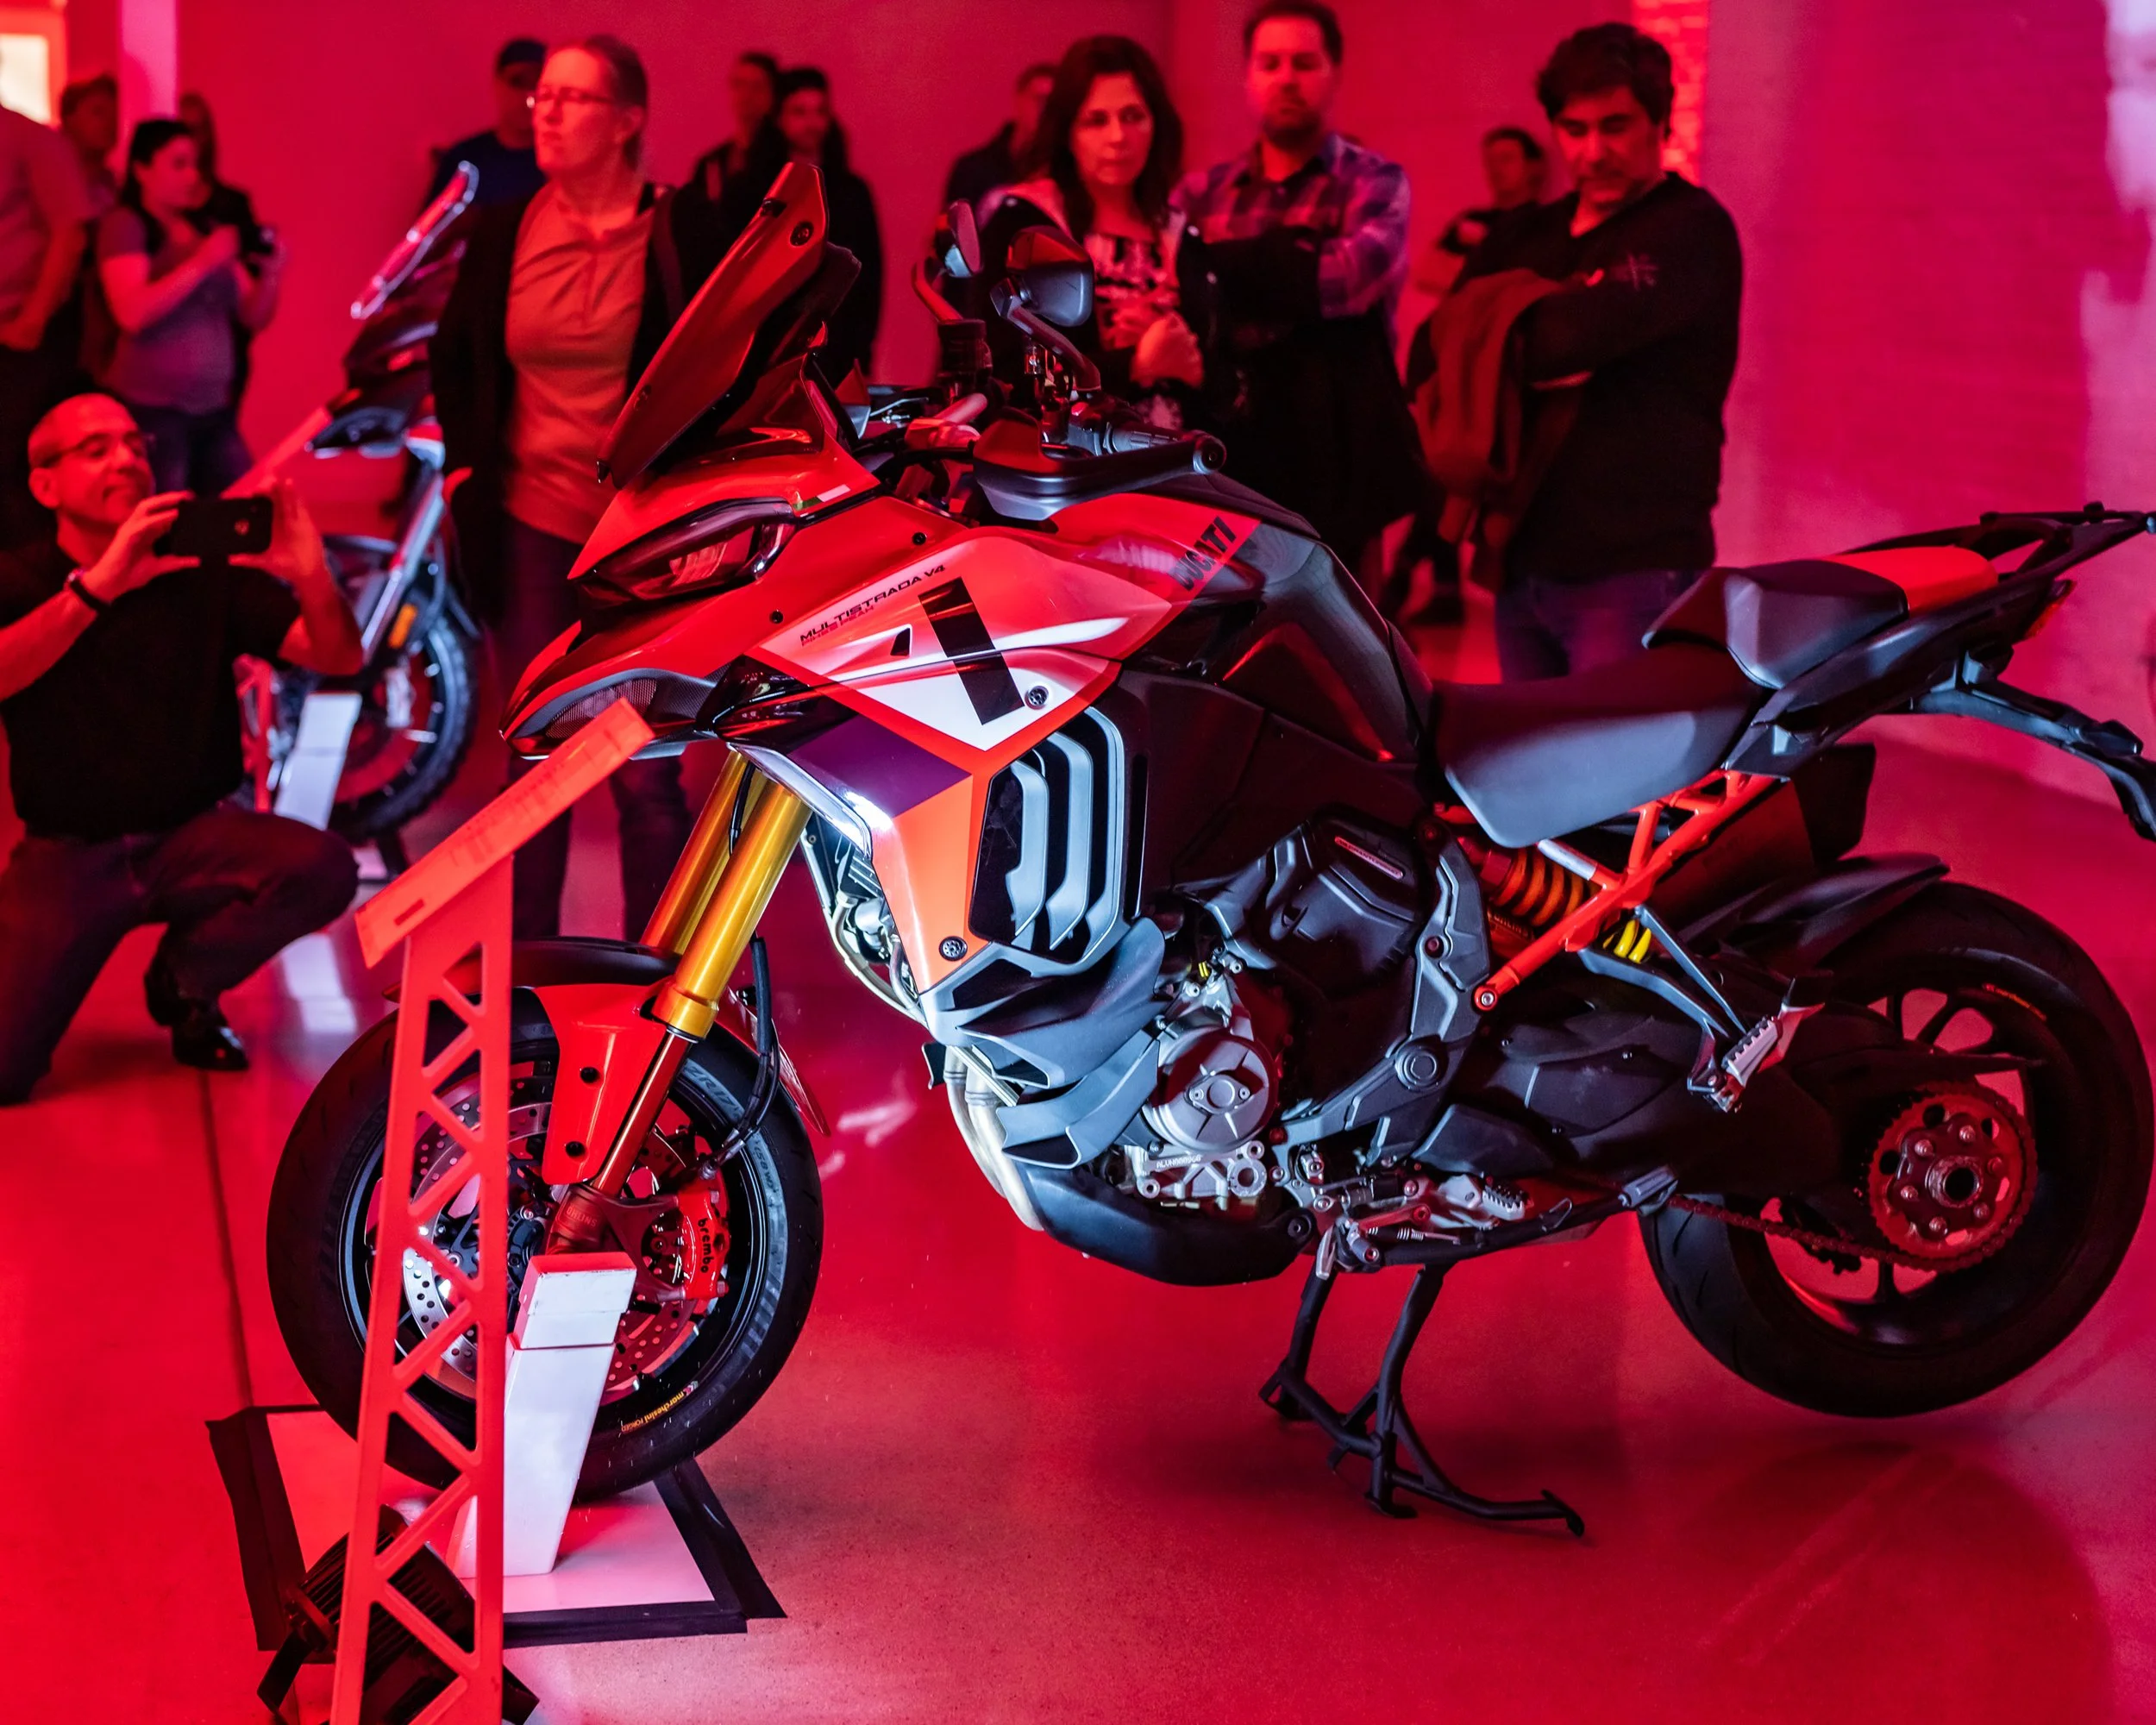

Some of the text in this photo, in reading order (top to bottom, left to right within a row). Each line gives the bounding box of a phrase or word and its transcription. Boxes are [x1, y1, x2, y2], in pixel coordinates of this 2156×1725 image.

[1167, 516, 1237, 592] DUCATI
[799, 564, 946, 643] MULTISTRADA V4
[698, 1218, 715, 1274] brembo
[643, 1390, 685, 1425] marchesini
